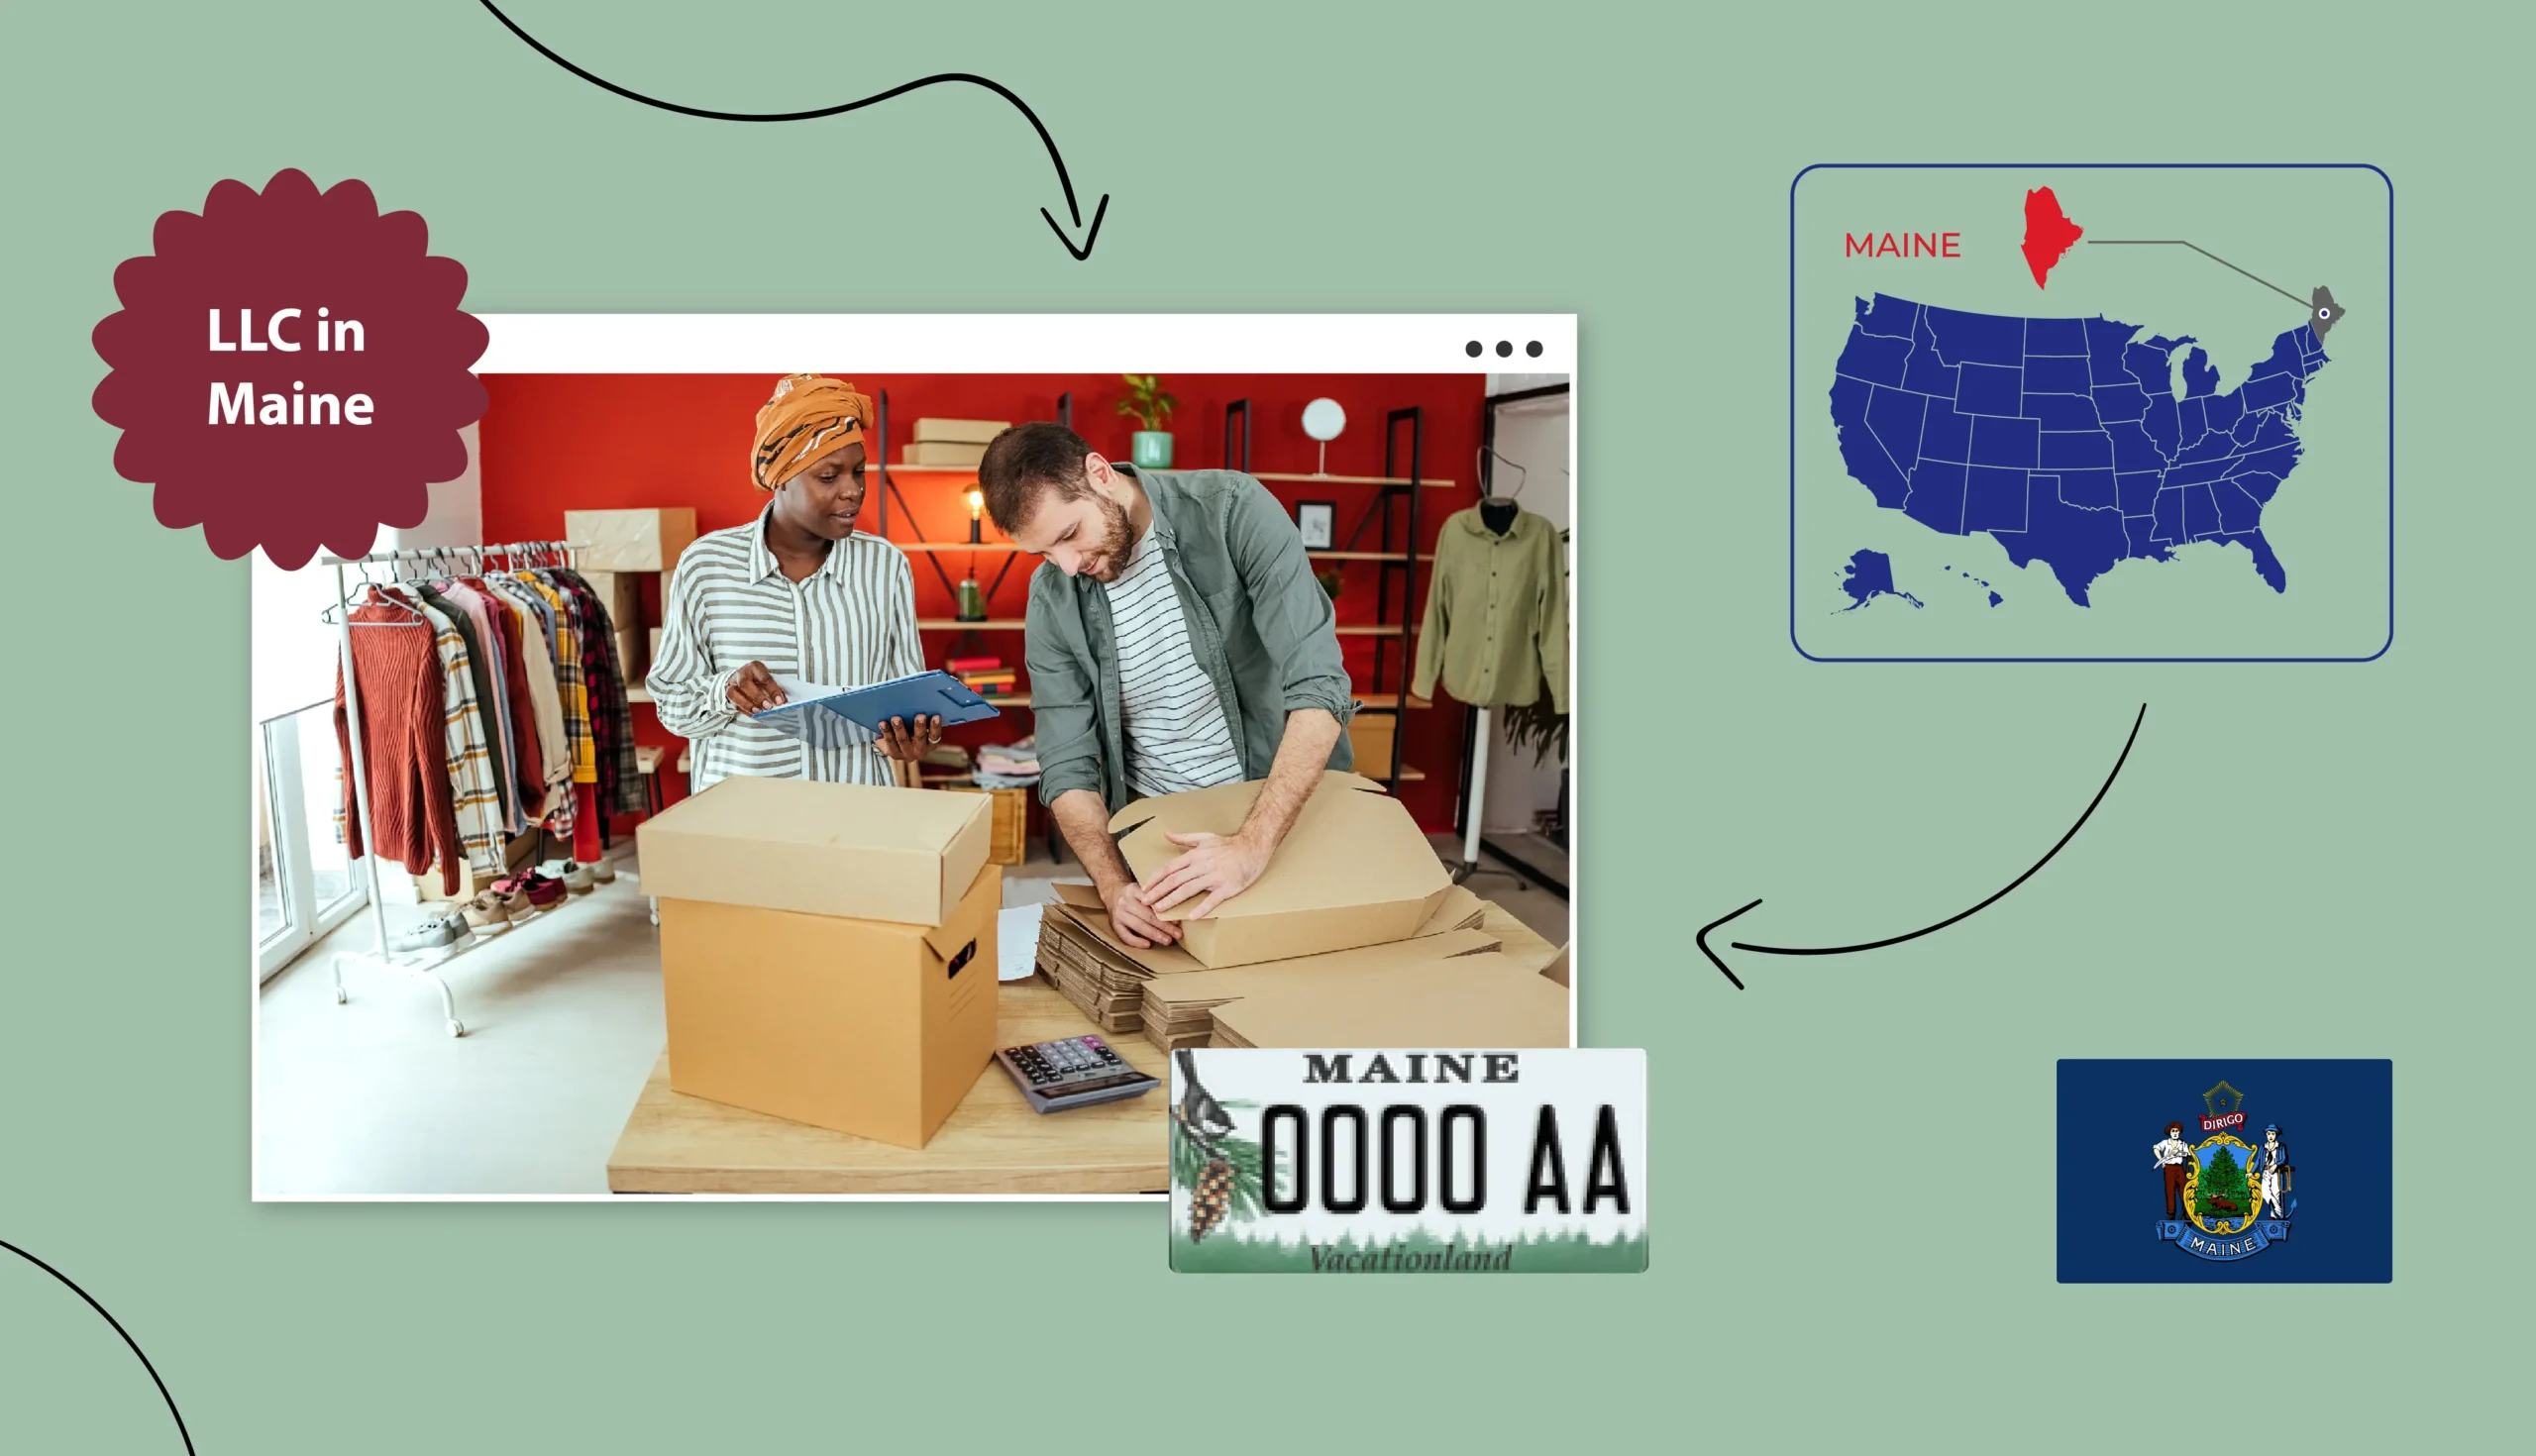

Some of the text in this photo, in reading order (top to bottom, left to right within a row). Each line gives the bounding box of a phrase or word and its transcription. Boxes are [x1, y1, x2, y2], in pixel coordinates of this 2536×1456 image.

[1303, 1054, 1520, 1084] MAINE
[2203, 1113, 2244, 1130] DIRIGO
[1262, 1103, 1631, 1215] 0000 AA
[1310, 1244, 1513, 1272] Vacationland
[2190, 1236, 2258, 1256] MAINE
